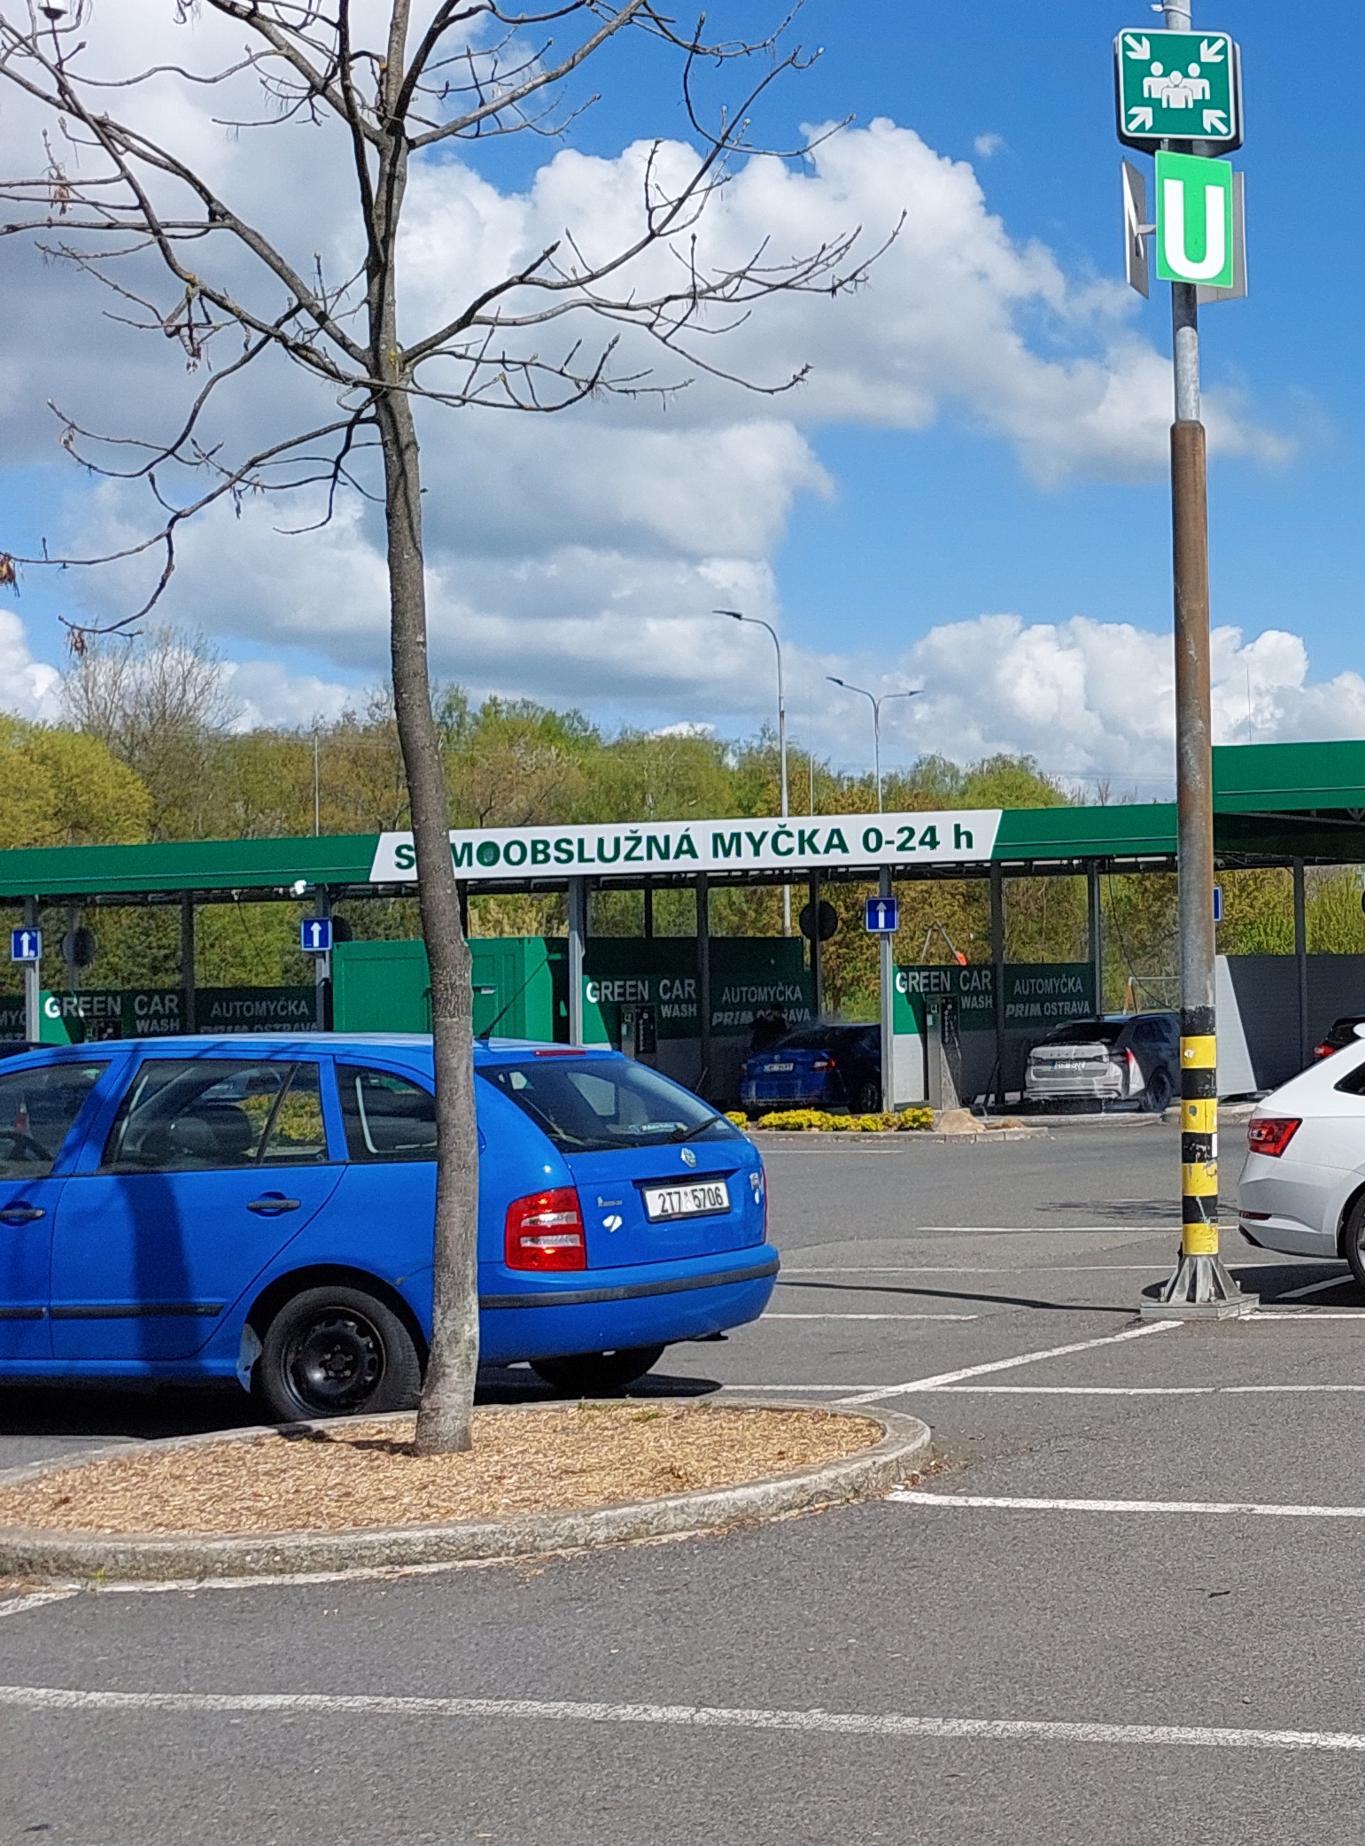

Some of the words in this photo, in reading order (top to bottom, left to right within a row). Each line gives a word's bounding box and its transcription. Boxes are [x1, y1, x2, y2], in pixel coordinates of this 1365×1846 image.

[1163, 178, 1225, 280] U
[394, 827, 699, 870] SMOOBSLUŽNÁ
[711, 823, 850, 859] MYČKA
[861, 825, 940, 853] 0-24
[954, 823, 974, 849] h
[586, 980, 649, 1003] GREEN
[658, 978, 697, 1000] CAR
[721, 981, 802, 1004] AUTOMYČKA
[895, 971, 950, 993] GREEN
[959, 970, 993, 991] CAR
[1013, 974, 1084, 996] AUTOMYČKA
[44, 995, 122, 1019] GREEN
[133, 993, 180, 1016] CAR
[660, 1003, 698, 1019] WASH
[961, 995, 993, 1009] WASH
[1005, 1003, 1043, 1018] PRIM
[1043, 1001, 1091, 1015] OSTRAVA
[135, 1018, 181, 1034] WASH
[693, 1187, 724, 1209] 5706
